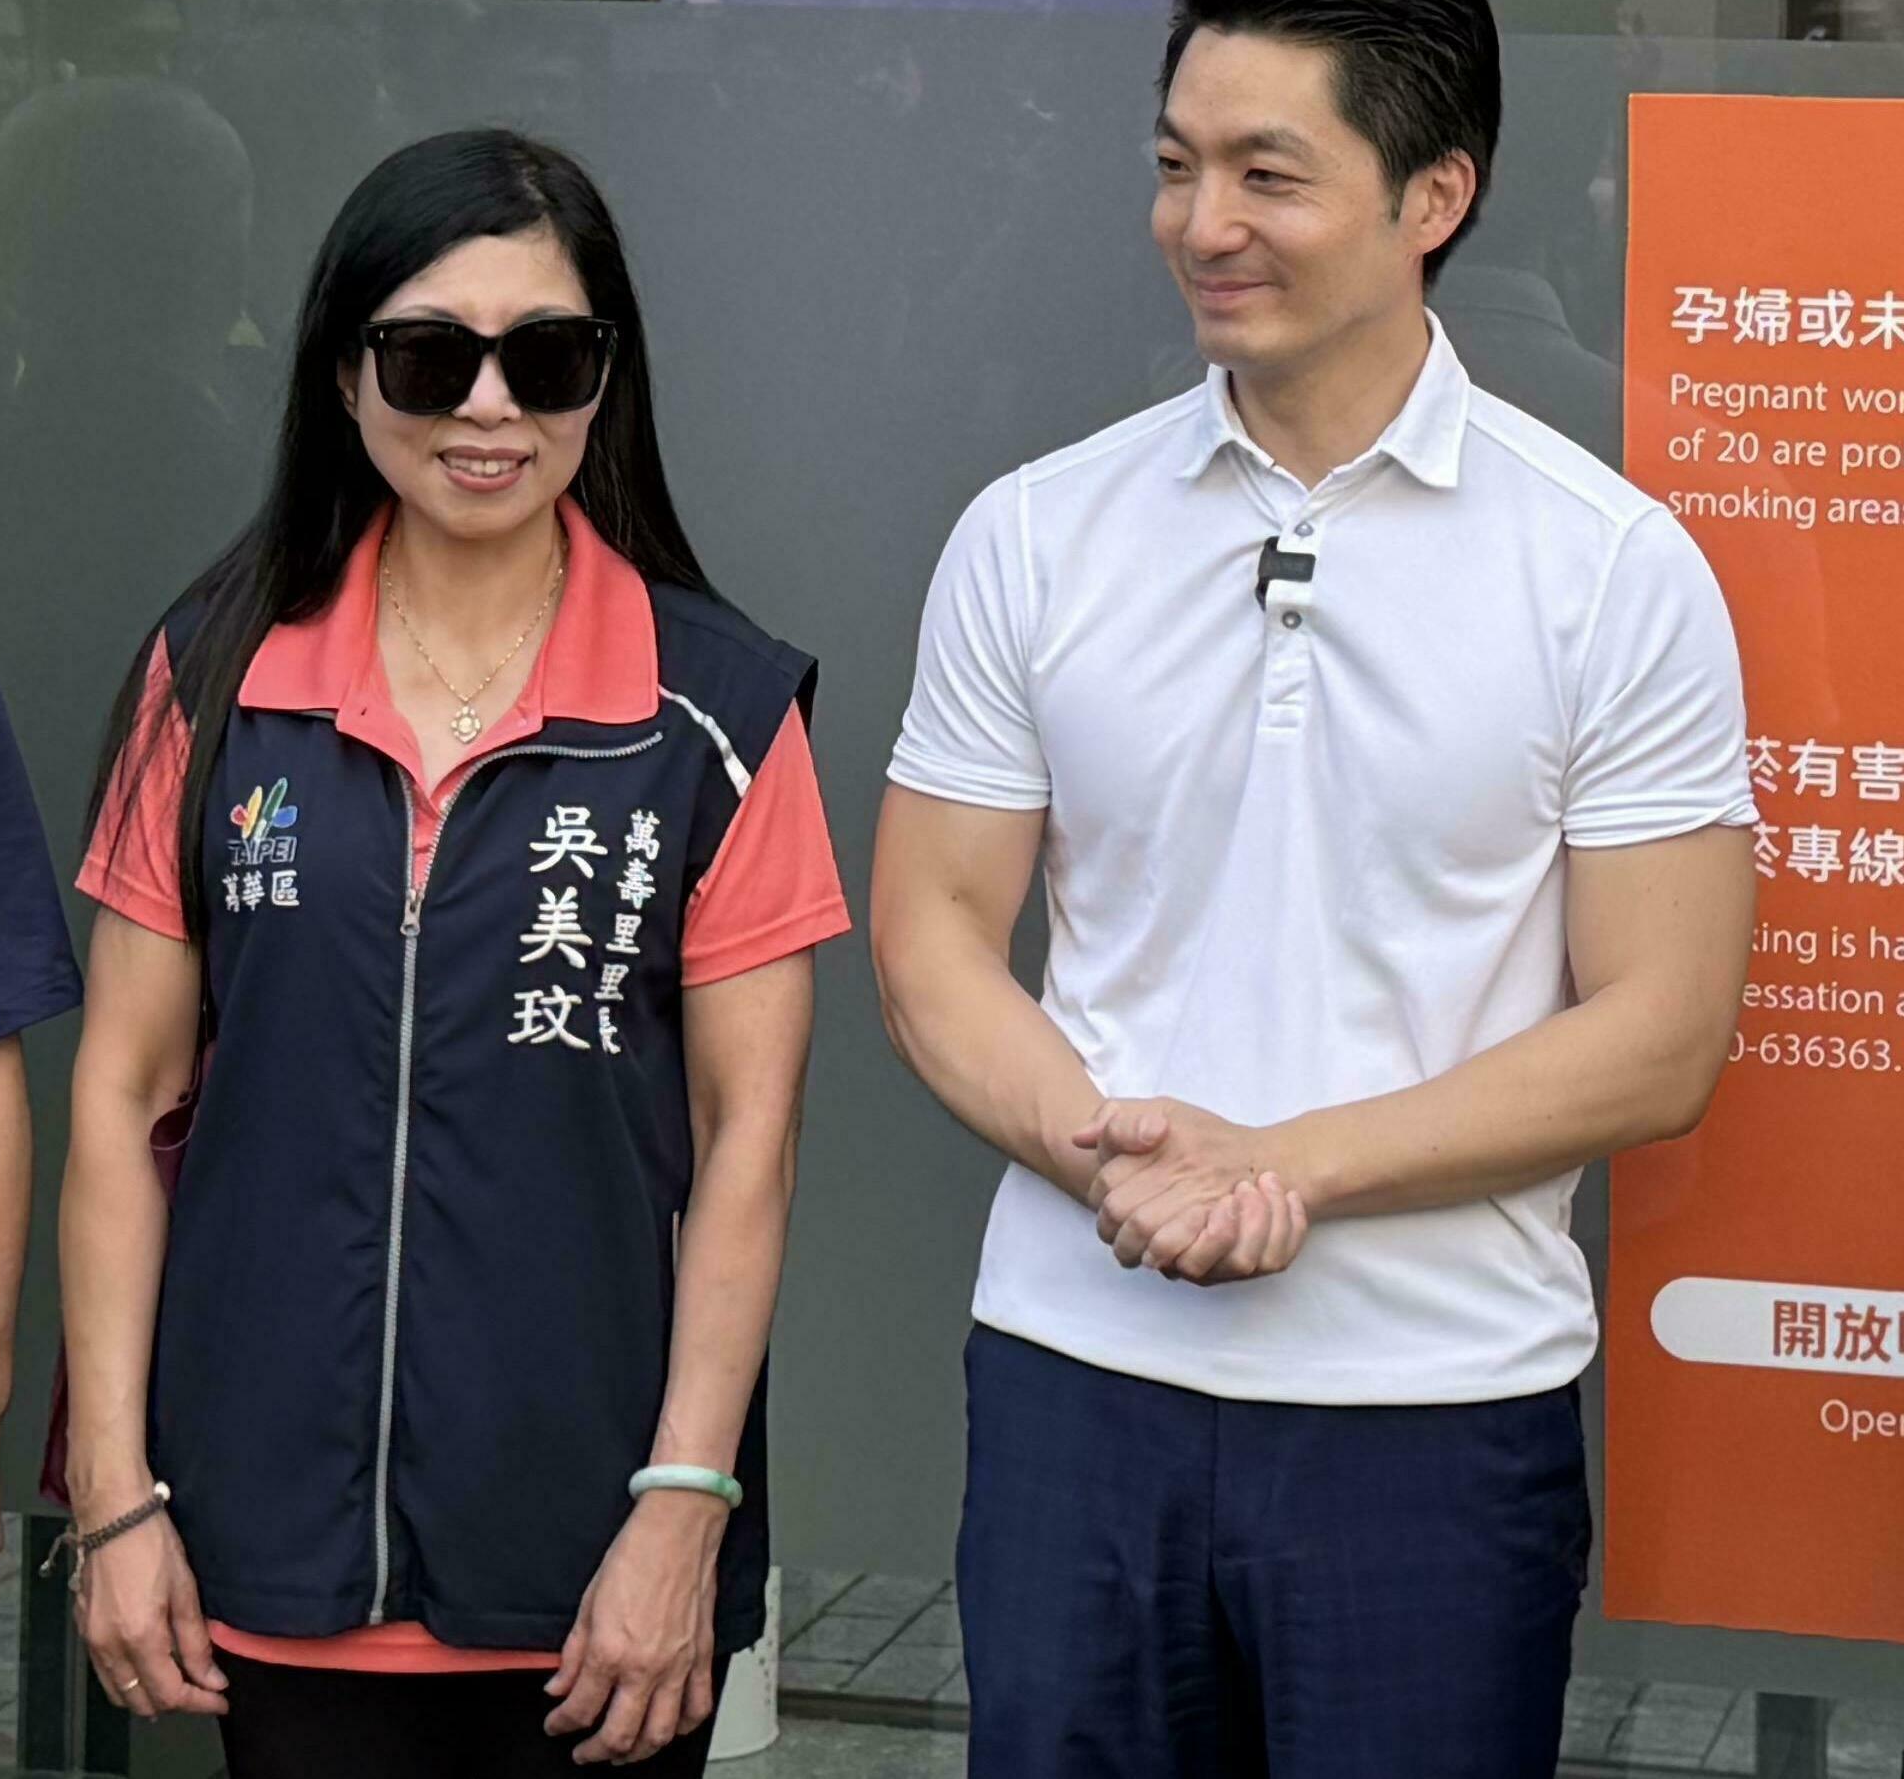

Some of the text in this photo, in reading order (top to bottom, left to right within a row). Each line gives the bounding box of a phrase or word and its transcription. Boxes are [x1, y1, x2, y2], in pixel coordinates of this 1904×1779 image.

[1669, 372, 1828, 418] Pregnant
[1668, 427, 1708, 463] of
[1716, 430, 1760, 464] 20
[1771, 439, 1827, 468] are
[1667, 485, 1817, 528] smoking
[507, 805, 608, 1051] 吳美玟
[1831, 925, 1857, 958] is
